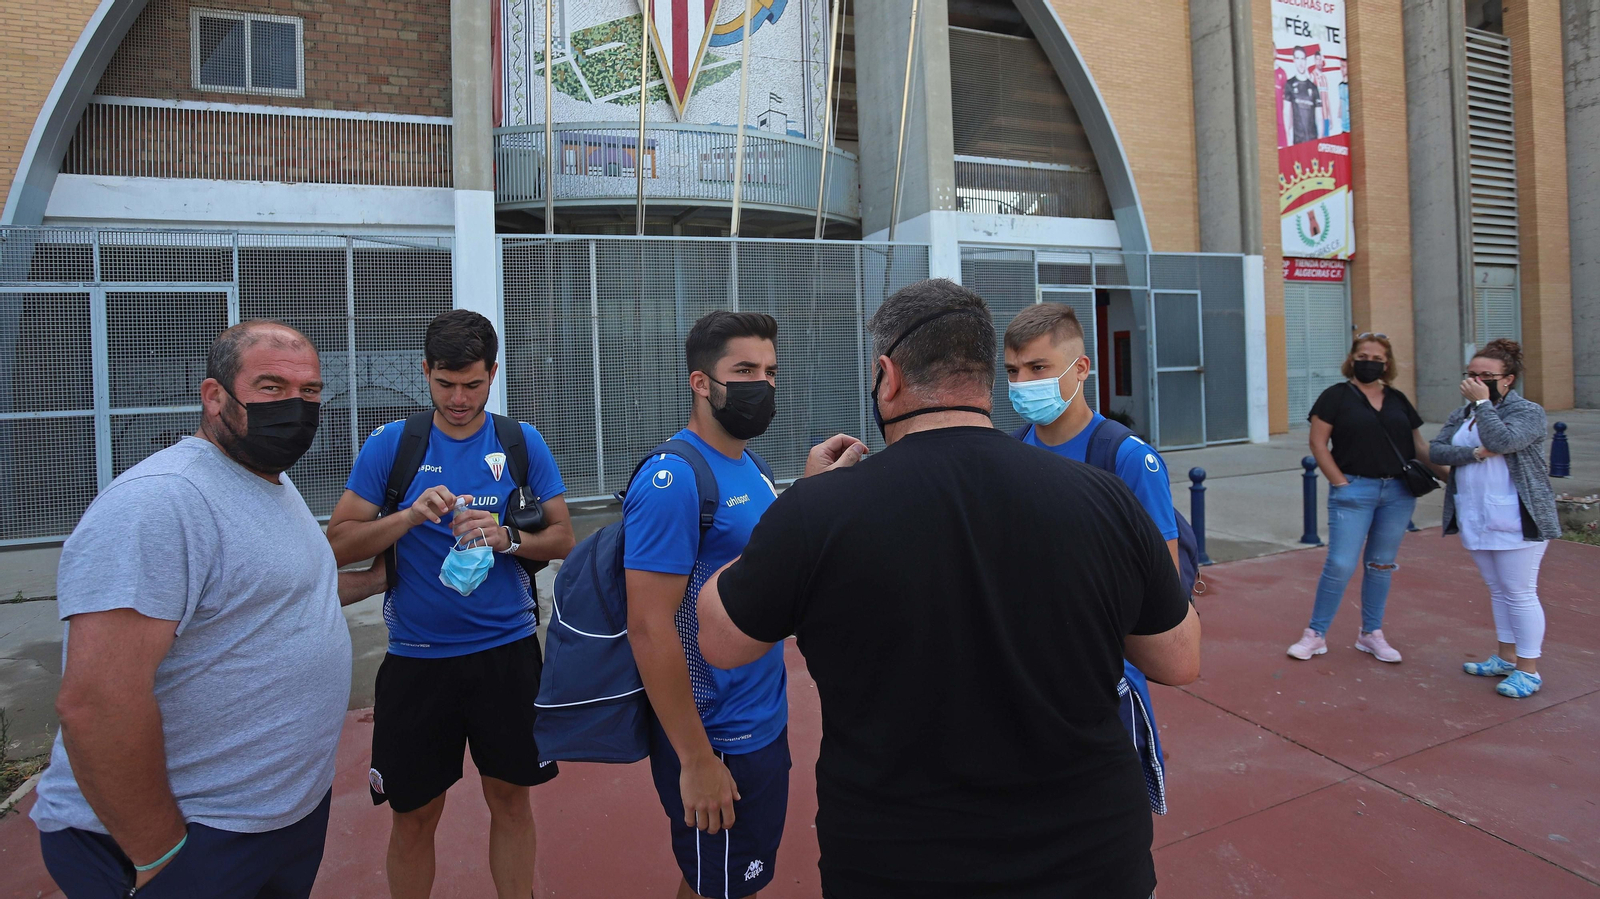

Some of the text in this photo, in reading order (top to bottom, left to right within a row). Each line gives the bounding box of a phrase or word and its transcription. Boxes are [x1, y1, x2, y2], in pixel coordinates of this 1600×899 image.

[1323, 3, 1335, 14] CF
[1295, 259, 1319, 268] TIENDA
[1294, 269, 1330, 278] ALGECIRAS
[418, 464, 442, 473] sport
[466, 496, 498, 507] LUID
[726, 493, 750, 507] uhlsport
